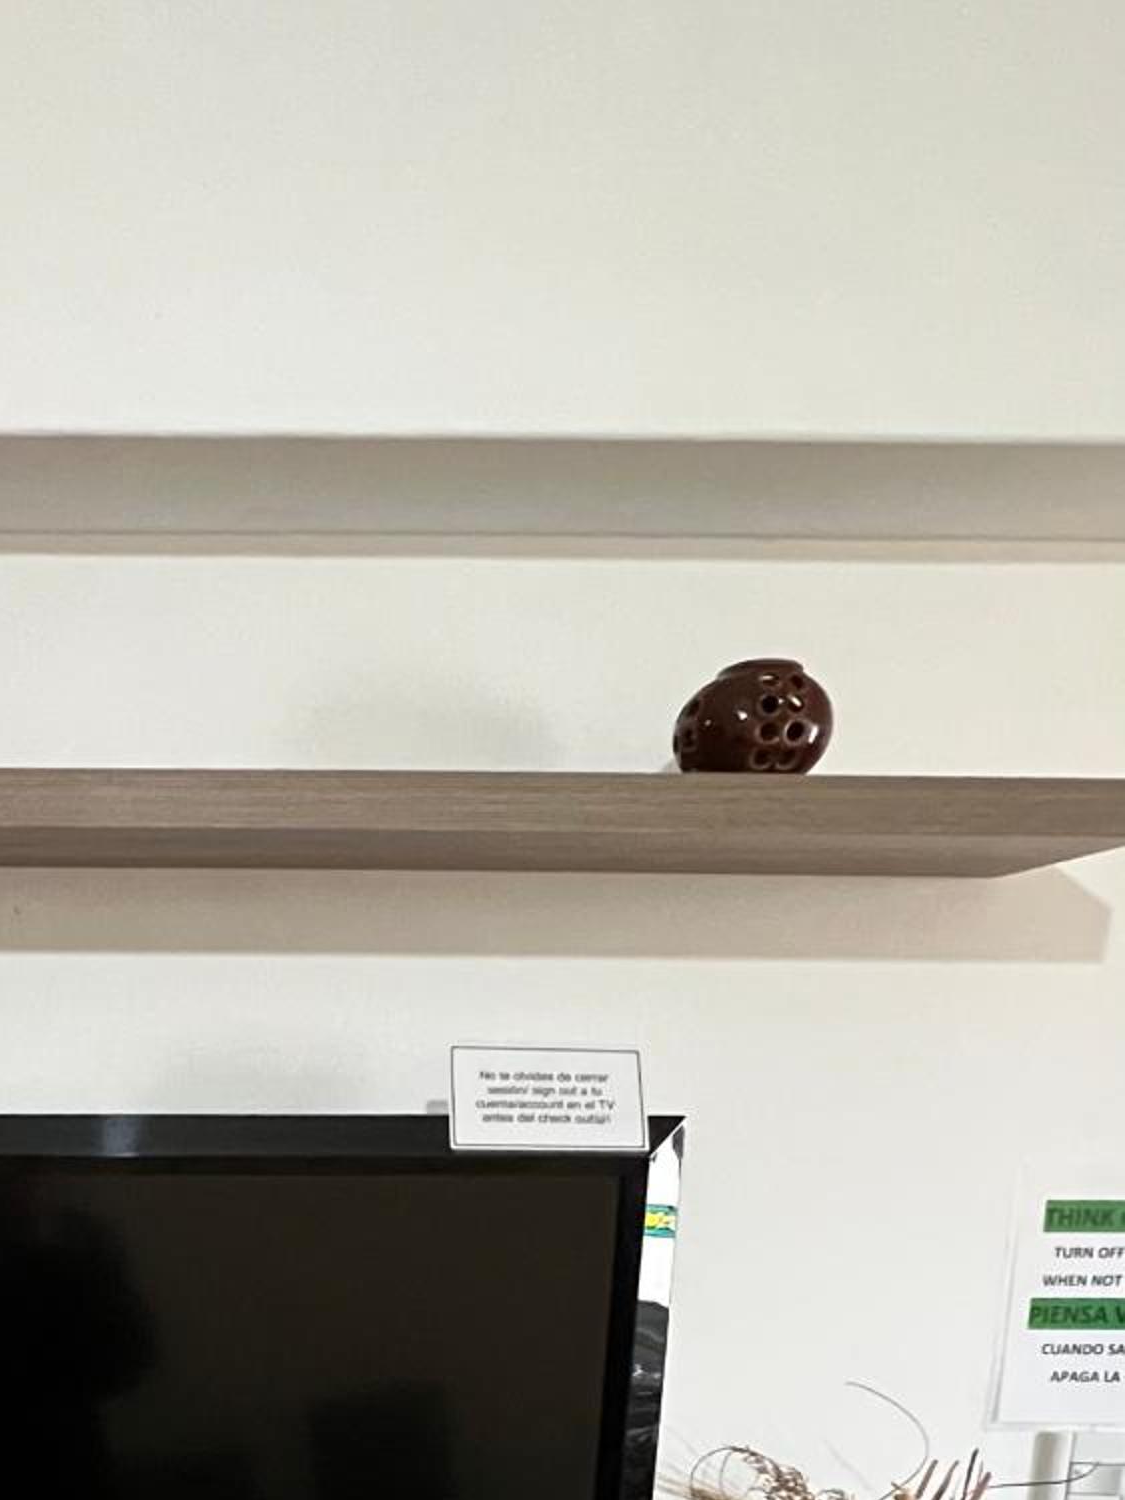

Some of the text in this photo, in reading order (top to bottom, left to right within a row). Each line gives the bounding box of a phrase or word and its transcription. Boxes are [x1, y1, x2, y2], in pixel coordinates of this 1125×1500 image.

[479, 1071, 609, 1084] No te olvides de cerrar
[532, 1087, 556, 1098] sign
[558, 1086, 578, 1096] out
[566, 1102, 582, 1111] en
[584, 1101, 596, 1111] el
[598, 1100, 616, 1112] TV
[482, 1113, 514, 1123] antes
[516, 1113, 535, 1124] del
[537, 1113, 572, 1125] check
[1045, 1207, 1115, 1227] THINK
[1055, 1246, 1125, 1259] TURN OFF
[1043, 1274, 1123, 1287] WHEN NOT
[1030, 1305, 1108, 1325] PIENSA
[1041, 1343, 1104, 1356] CUANDO
[1050, 1370, 1121, 1384] APAGA LA
